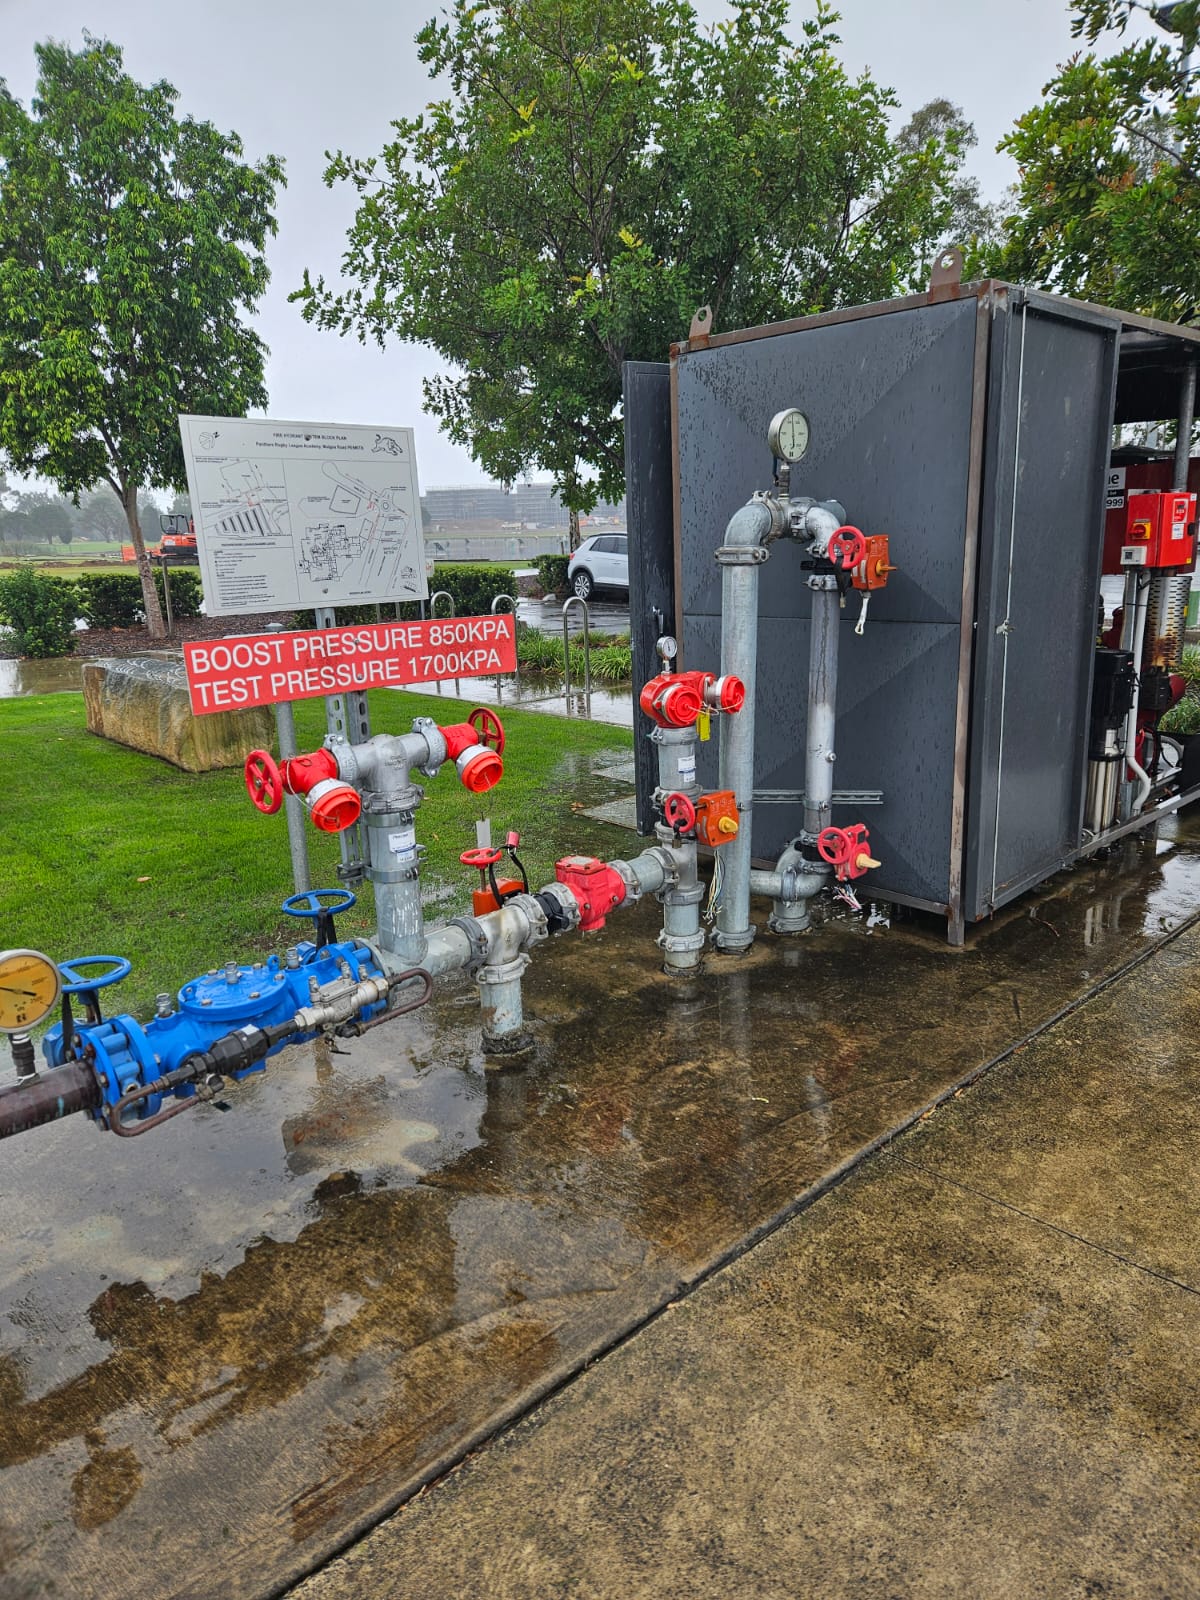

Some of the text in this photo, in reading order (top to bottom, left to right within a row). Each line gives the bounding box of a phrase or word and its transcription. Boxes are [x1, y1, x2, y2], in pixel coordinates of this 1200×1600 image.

[190, 619, 510, 674] BOOST PRESSURE 850KPA
[194, 648, 502, 707] TEST PRESSURE 1700KPA
